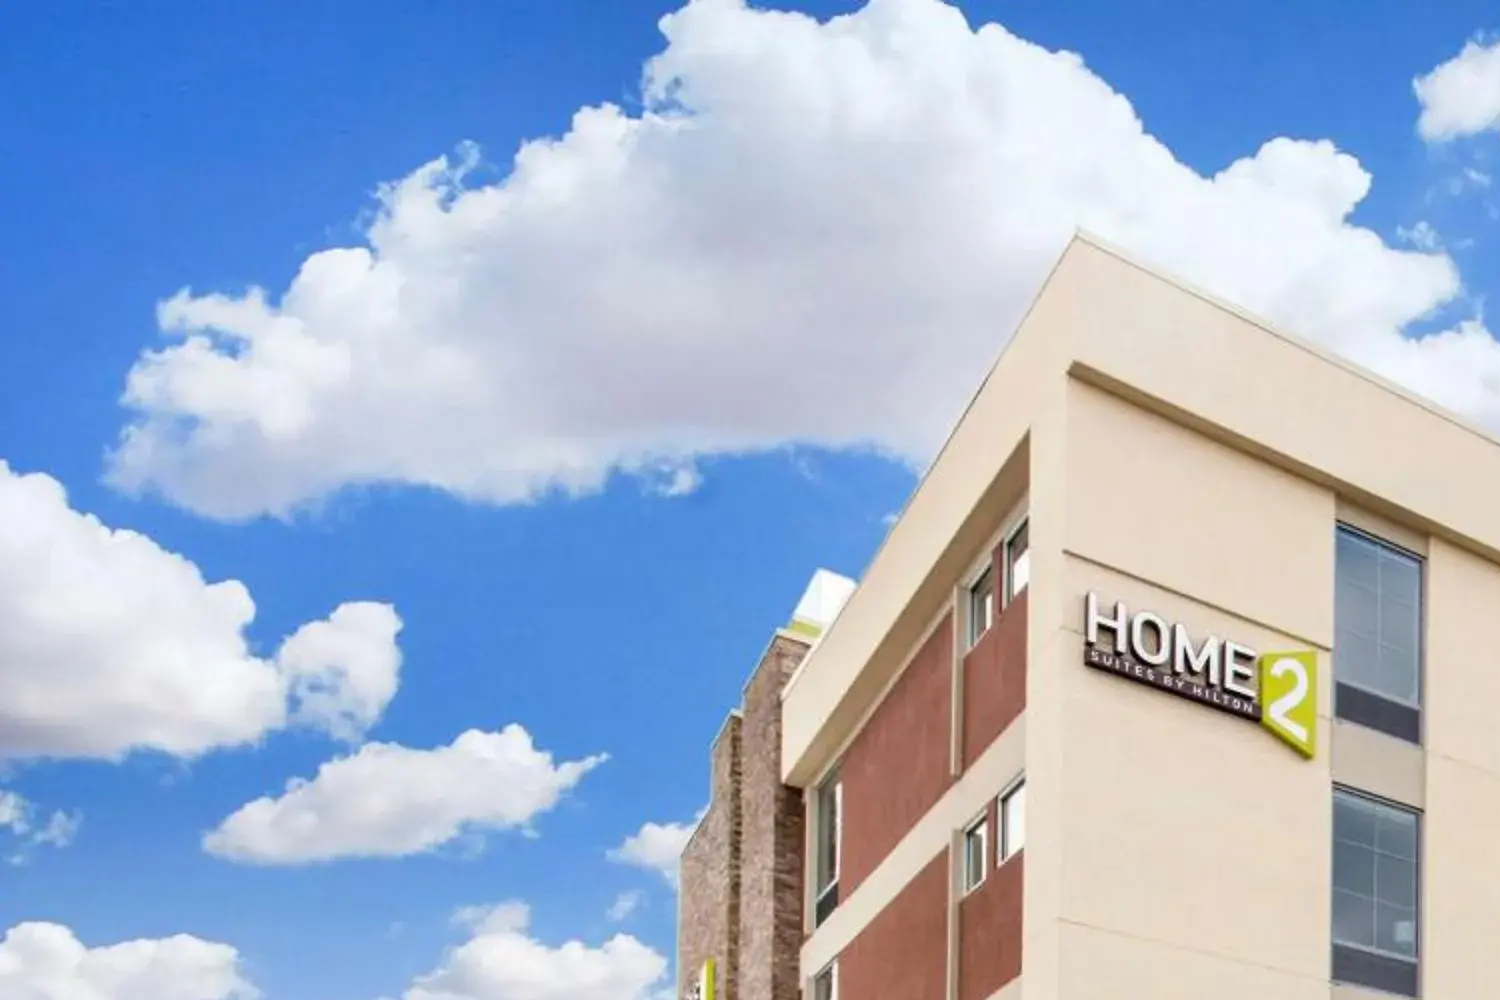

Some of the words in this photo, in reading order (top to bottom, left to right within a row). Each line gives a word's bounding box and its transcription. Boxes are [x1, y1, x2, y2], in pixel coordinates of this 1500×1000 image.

[1086, 590, 1256, 698] HOME
[1268, 657, 1309, 743] 2
[1091, 650, 1155, 681] SUITES
[1163, 674, 1185, 689] BY
[1192, 684, 1254, 713] HILTON
